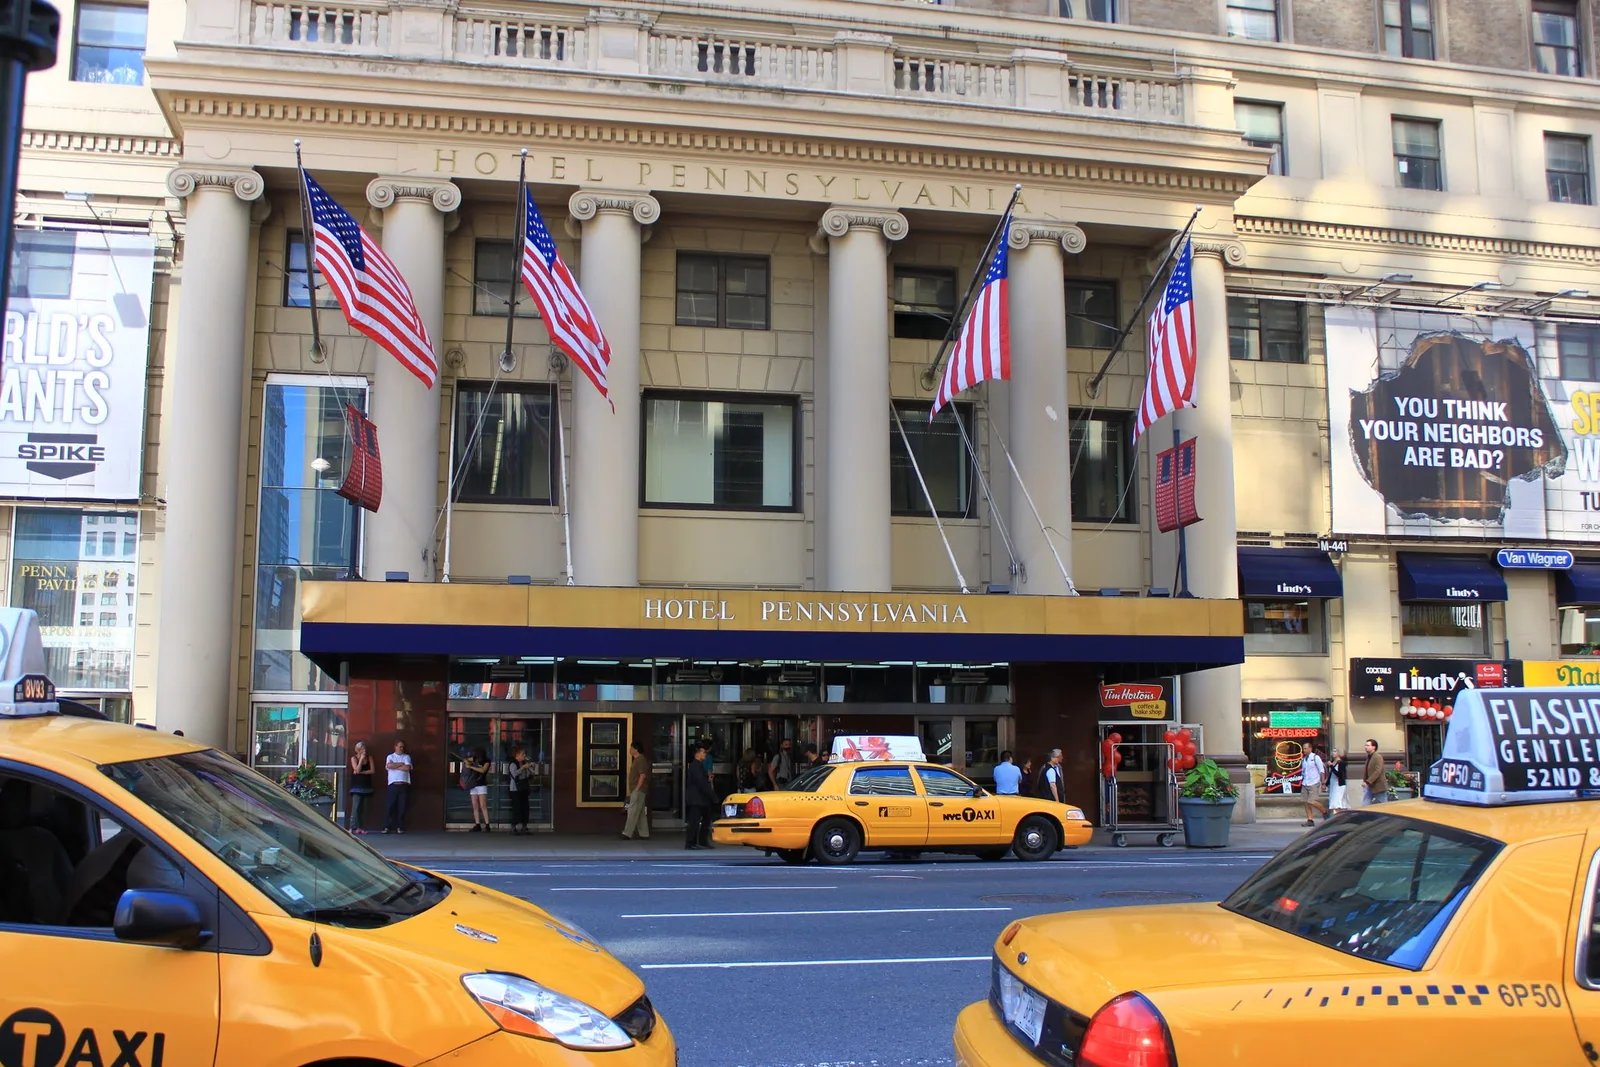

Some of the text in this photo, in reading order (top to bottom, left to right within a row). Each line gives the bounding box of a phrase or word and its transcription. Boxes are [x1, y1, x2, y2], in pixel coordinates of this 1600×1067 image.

[434, 149, 1032, 214] HOTEL PENNSYLVANIA
[1394, 397, 1508, 422] YOU THINK
[1359, 419, 1544, 448] YOUR NEIGHBORS
[18, 444, 105, 461] SPIKE
[1404, 446, 1504, 469] ARE BAD?
[1320, 540, 1348, 552] M-441
[1504, 551, 1568, 567] Van Wagner
[21, 565, 67, 577] PENN
[1277, 582, 1312, 593] Lindy's
[1446, 586, 1479, 597] Lindy's
[645, 598, 969, 625] HOTEL PENNSYLVANIA
[25, 679, 45, 698] 8V93
[1399, 670, 1475, 692] Lindy's
[1104, 688, 1155, 699] Tim Hortons
[1261, 728, 1318, 737] GREAT BURGERS
[1500, 738, 1600, 763] GENTLE
[1442, 762, 1469, 786] 6P50
[1527, 767, 1581, 787] 52ND
[943, 807, 995, 822] NYC TAXI
[1498, 984, 1562, 1008] 6P50
[0, 1007, 166, 1067] TAXI
